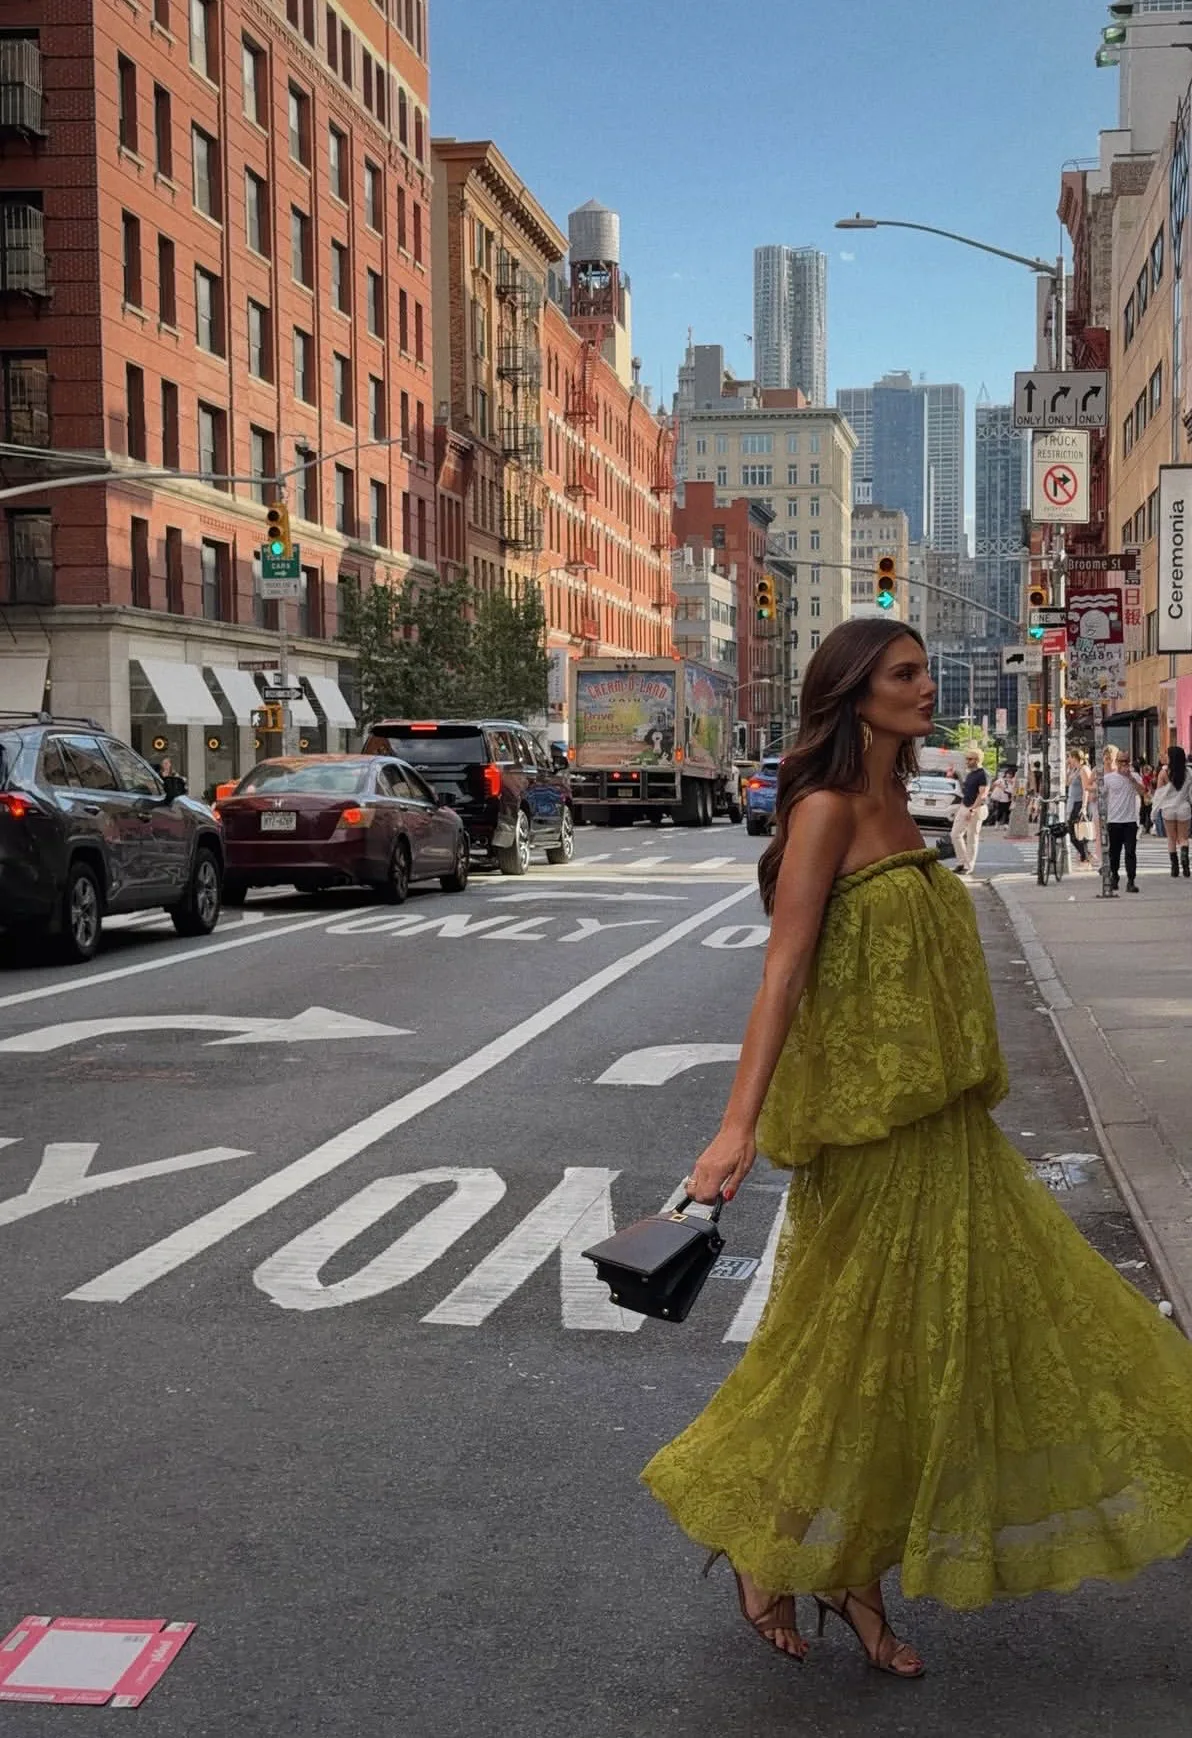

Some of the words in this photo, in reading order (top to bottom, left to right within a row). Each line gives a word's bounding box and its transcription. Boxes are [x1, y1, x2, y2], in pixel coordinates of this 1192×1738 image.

[1017, 415, 1042, 426] ONLY
[1048, 415, 1072, 425] ONLY
[1079, 414, 1103, 424] ONLY
[1044, 435, 1077, 447] TRUCK
[1037, 448, 1084, 460] RESTRICTION
[1068, 558, 1107, 570] Broome
[1111, 558, 1120, 570] St
[1167, 499, 1185, 620] Ceremonia
[325, 913, 665, 943] ONLY
